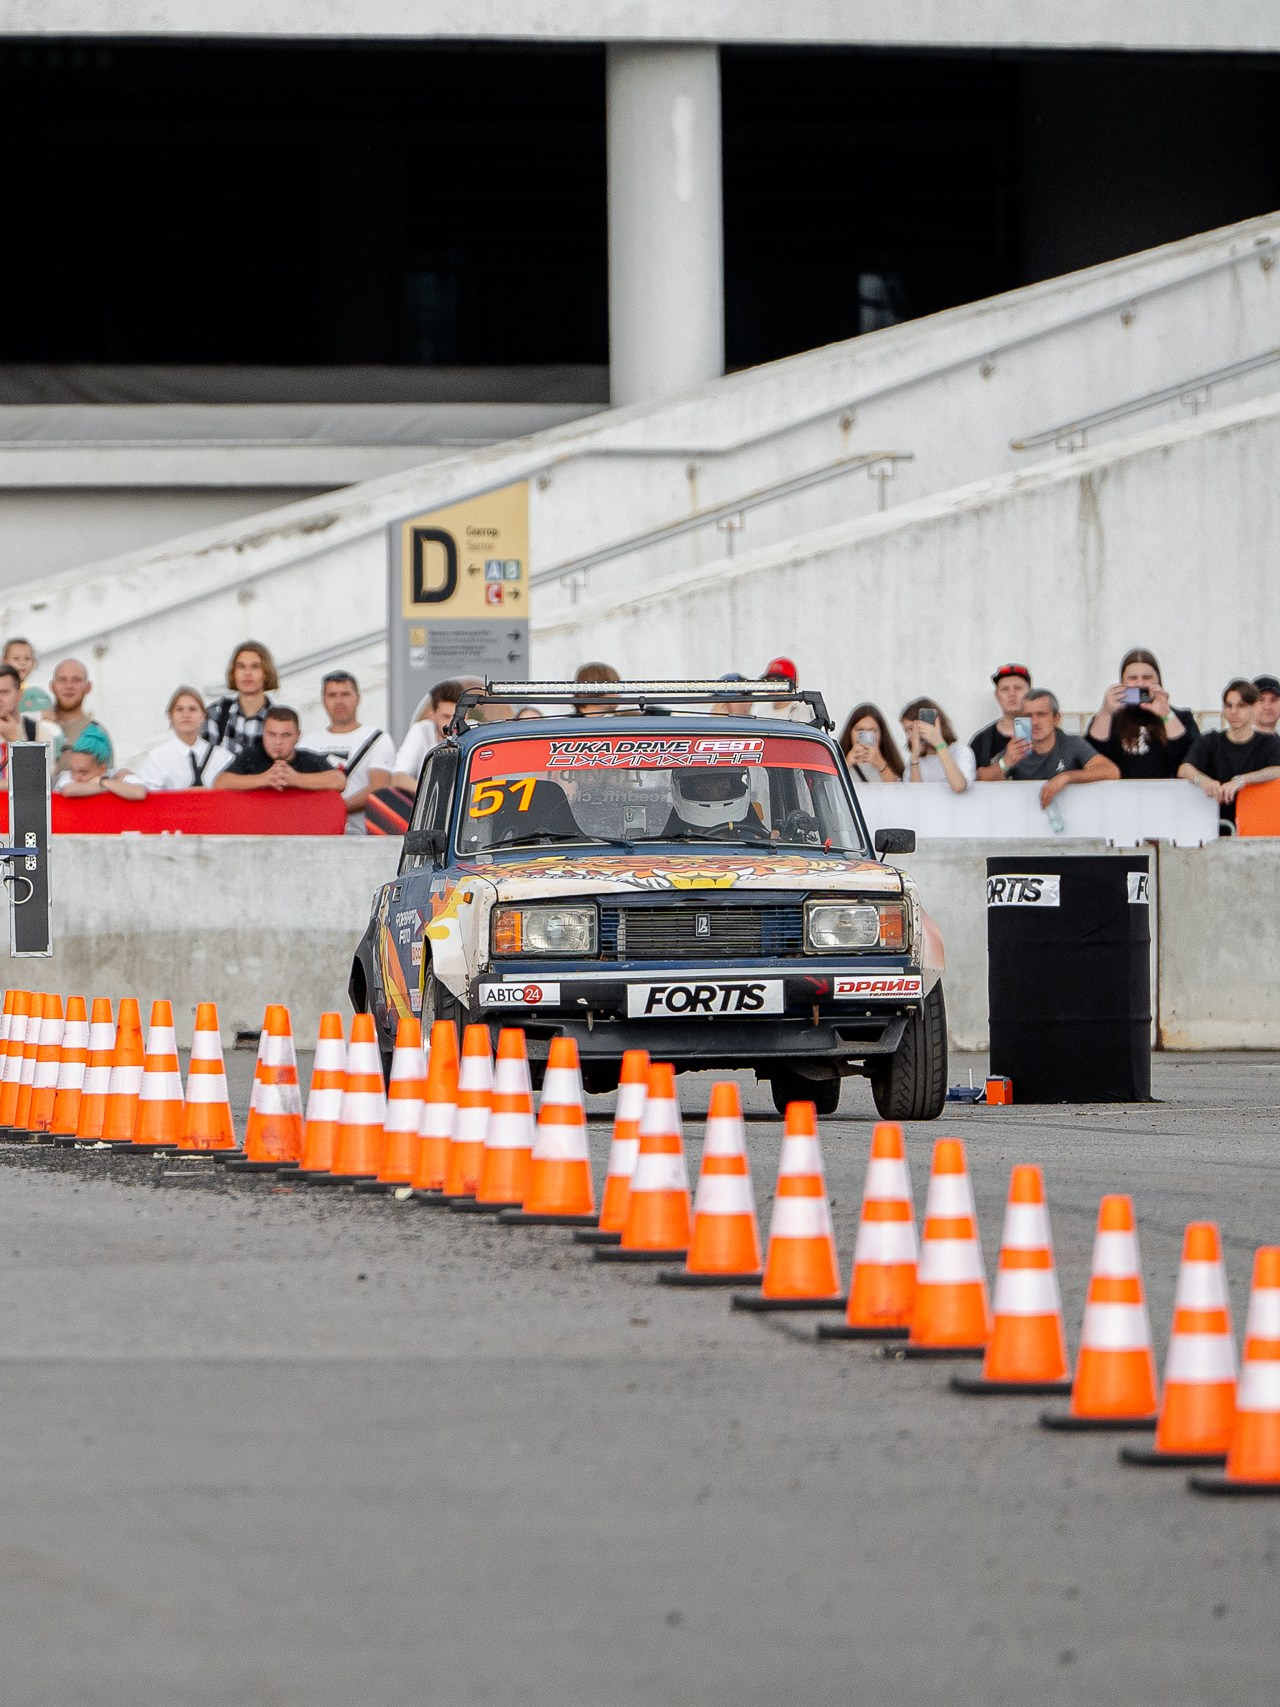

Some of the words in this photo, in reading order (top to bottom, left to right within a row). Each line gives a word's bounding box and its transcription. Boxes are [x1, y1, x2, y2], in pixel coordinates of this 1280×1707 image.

[412, 527, 458, 604] D
[549, 741, 613, 754] YUKA
[614, 740, 690, 754] DRIVE
[697, 739, 763, 751] FEST
[546, 752, 763, 767] ДЖИМХАНА
[469, 777, 537, 818] 51
[837, 978, 921, 993] ДРАЙВ
[643, 983, 767, 1014] FORTIS
